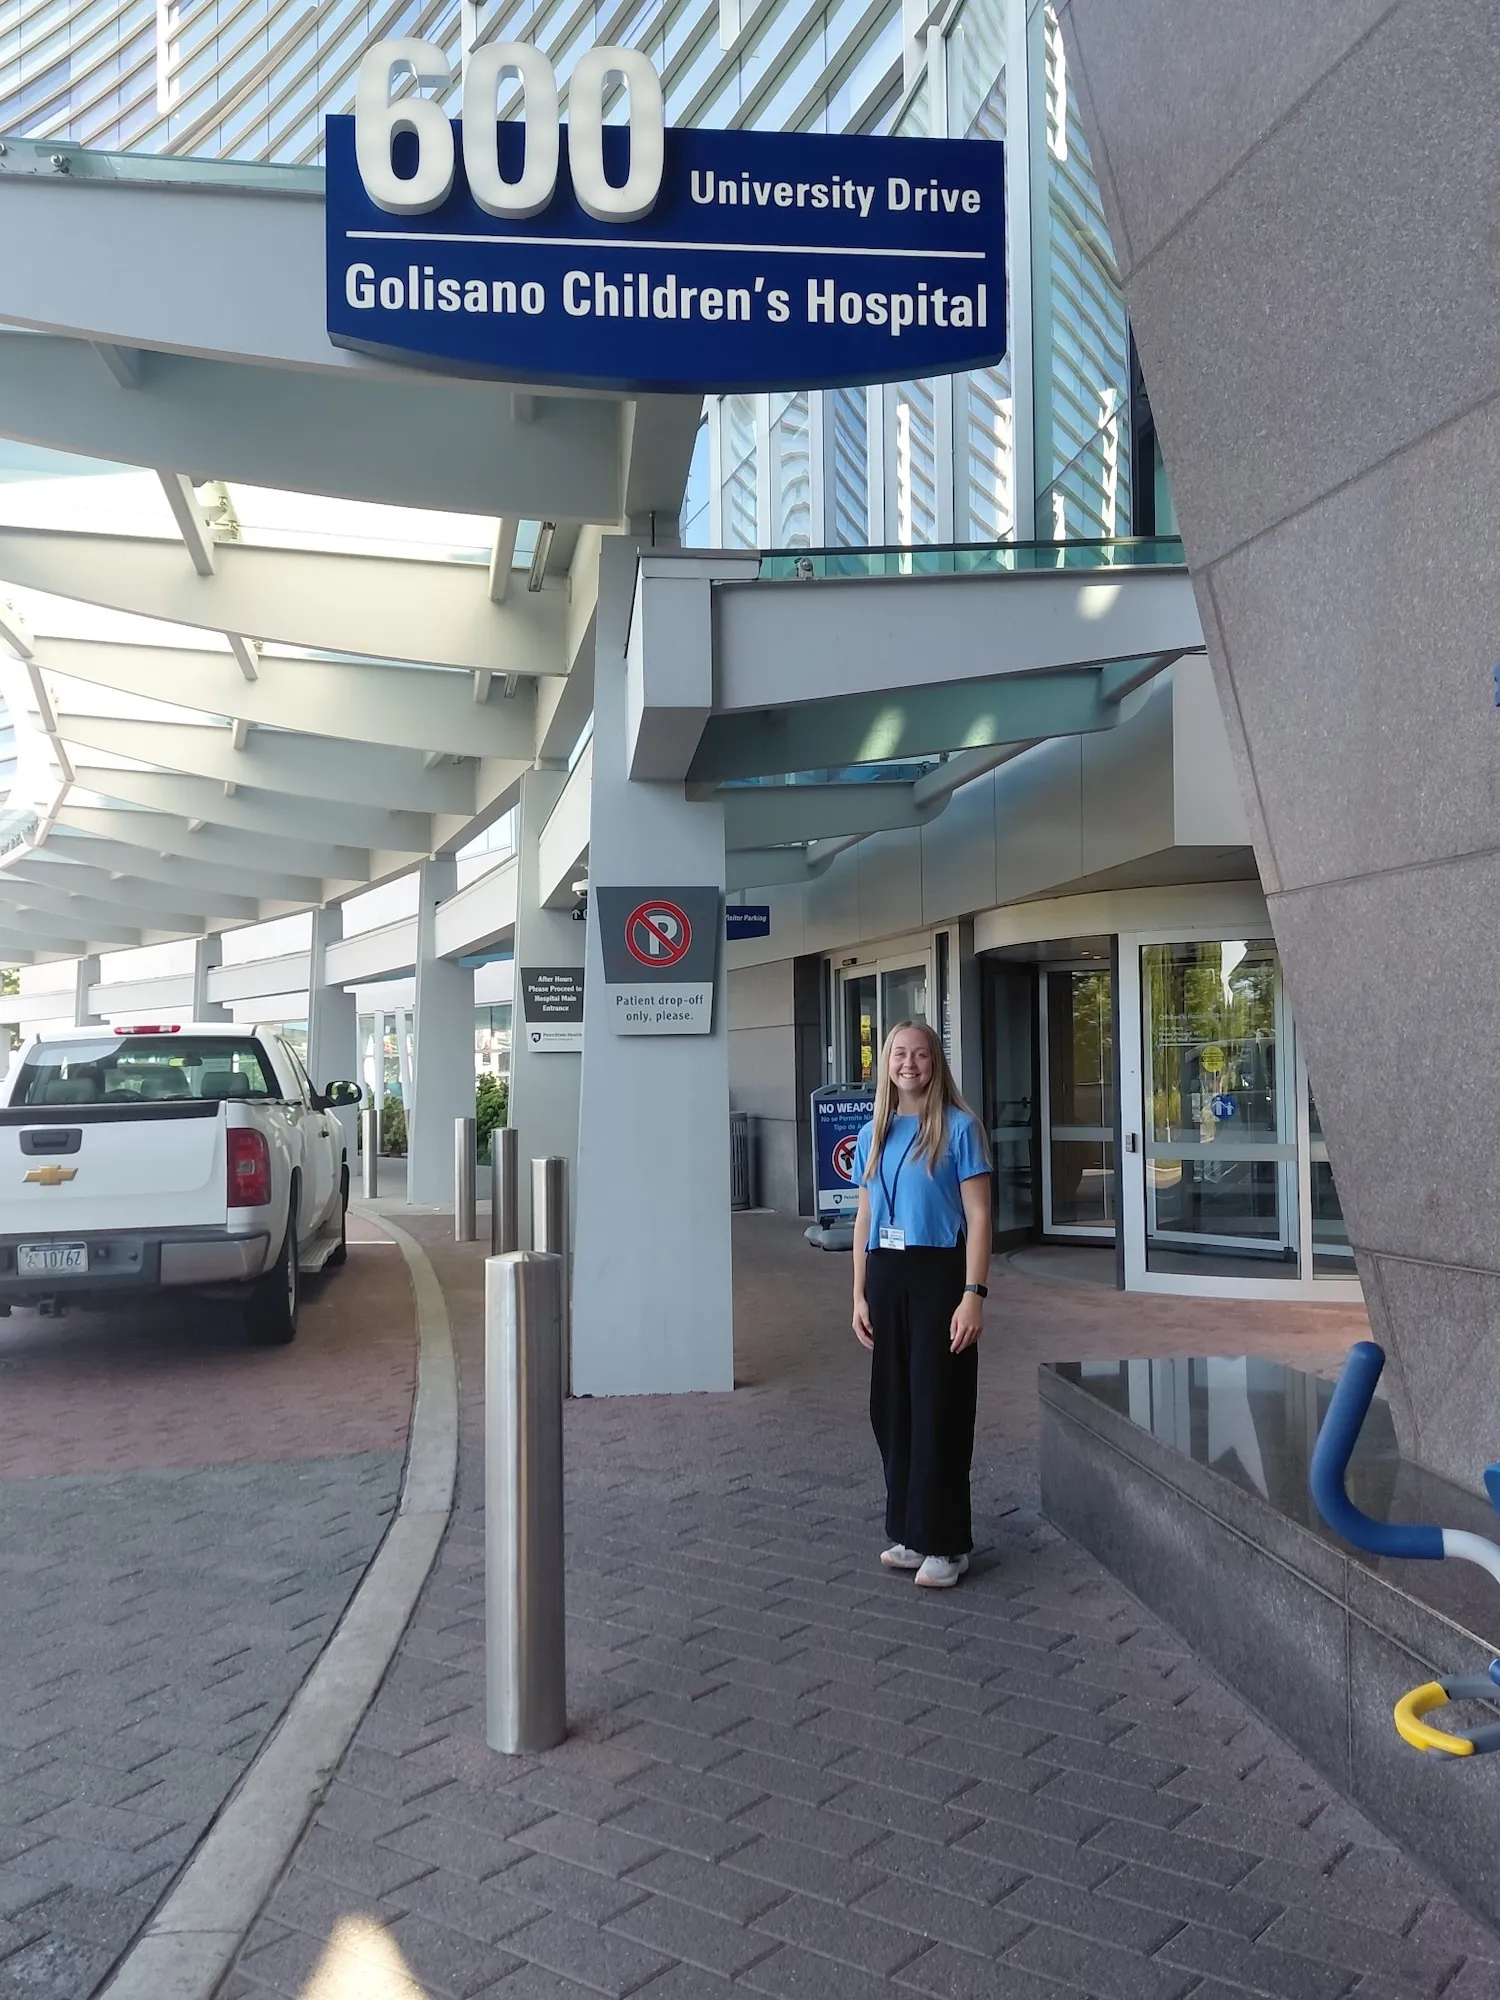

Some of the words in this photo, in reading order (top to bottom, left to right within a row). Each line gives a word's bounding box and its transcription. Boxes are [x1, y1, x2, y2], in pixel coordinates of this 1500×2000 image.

[355, 36, 665, 222] 600
[691, 169, 874, 217] University
[888, 178, 981, 214] Drive
[345, 263, 545, 315] Golisano
[561, 270, 790, 323] Children's
[807, 278, 987, 336] Hospital
[744, 914, 767, 923] Parking
[537, 975, 554, 983] After
[554, 975, 573, 983] Hours
[534, 995, 560, 1003] Hospital
[616, 995, 655, 1006] Patient
[658, 994, 704, 1007] drop-off
[542, 1004, 570, 1012] Entrance
[626, 1010, 652, 1023] only,
[656, 1010, 694, 1023] please.
[819, 1104, 834, 1114] NO
[836, 1102, 873, 1113] WEAPO
[833, 1123, 847, 1132] Tipo
